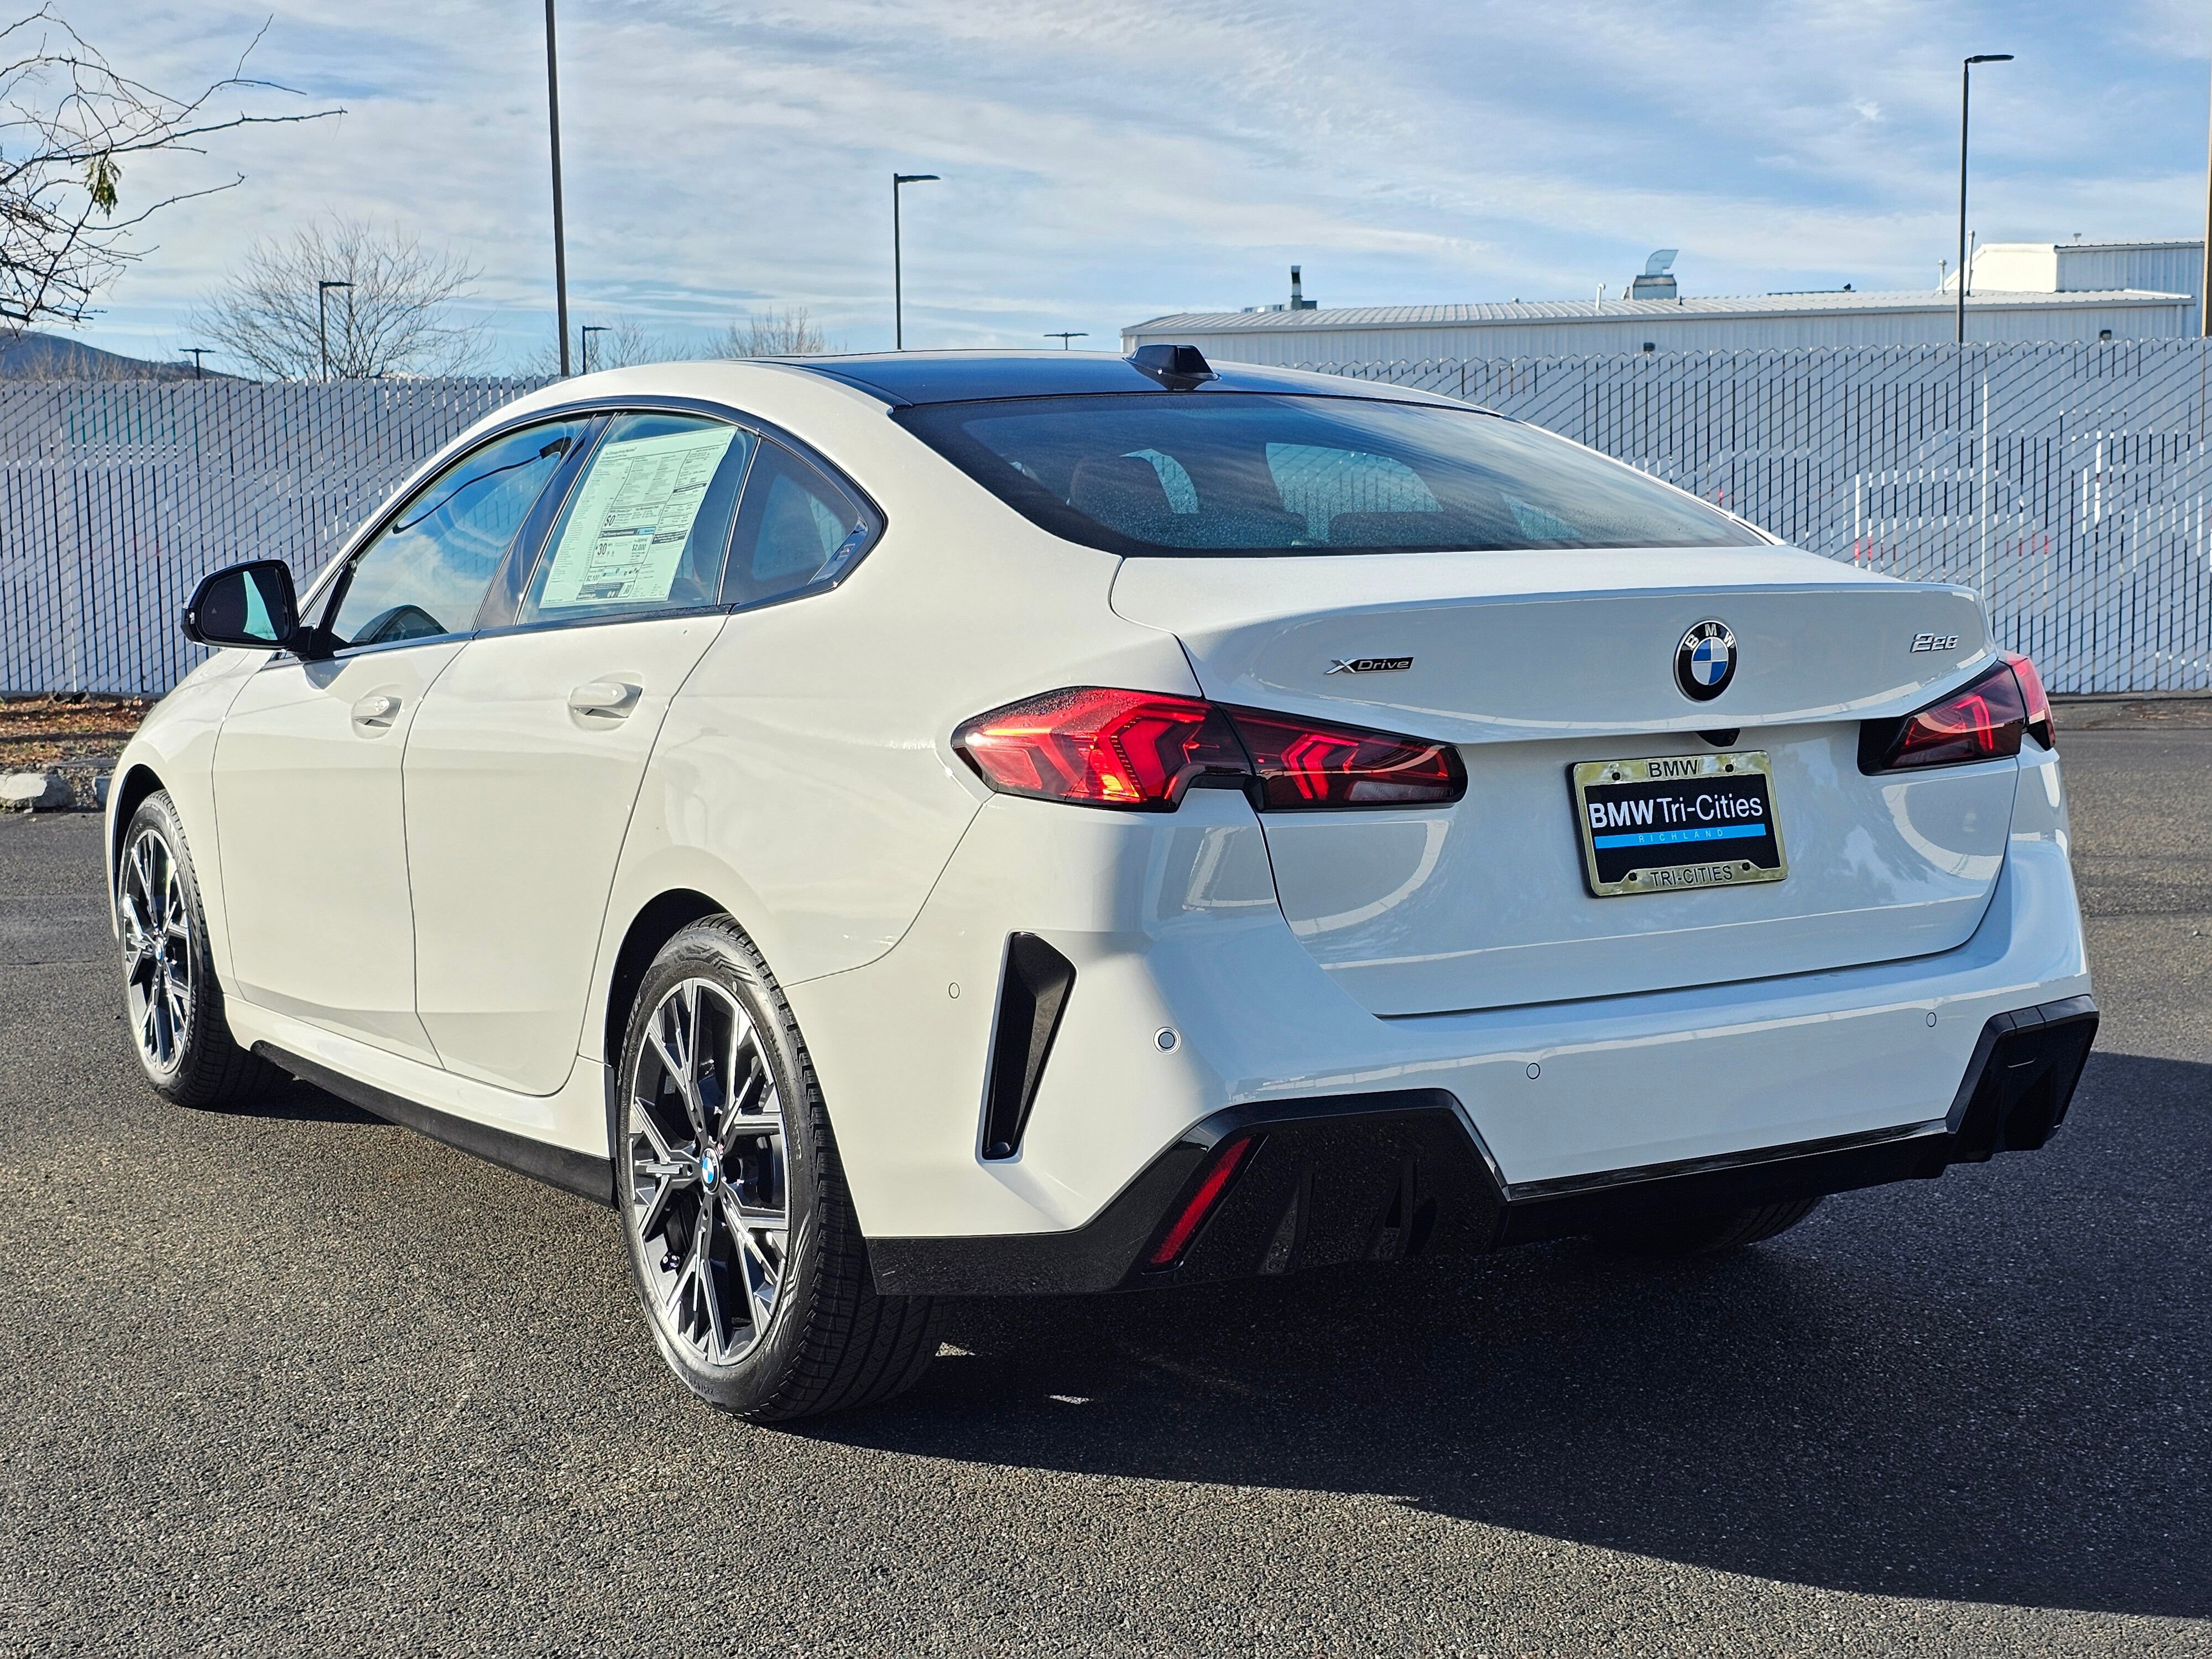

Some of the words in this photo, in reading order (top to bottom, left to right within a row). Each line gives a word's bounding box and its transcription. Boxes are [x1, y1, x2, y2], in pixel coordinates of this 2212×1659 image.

[1684, 623, 1734, 650] BMW
[1910, 633, 1959, 653] 228
[1648, 759, 1698, 778] BMW
[1589, 799, 1654, 828] BMW
[1657, 793, 1764, 823] Tri-Cities
[1638, 828, 1724, 843] RICHLAND
[1650, 865, 1733, 887] TRI-CITIES
